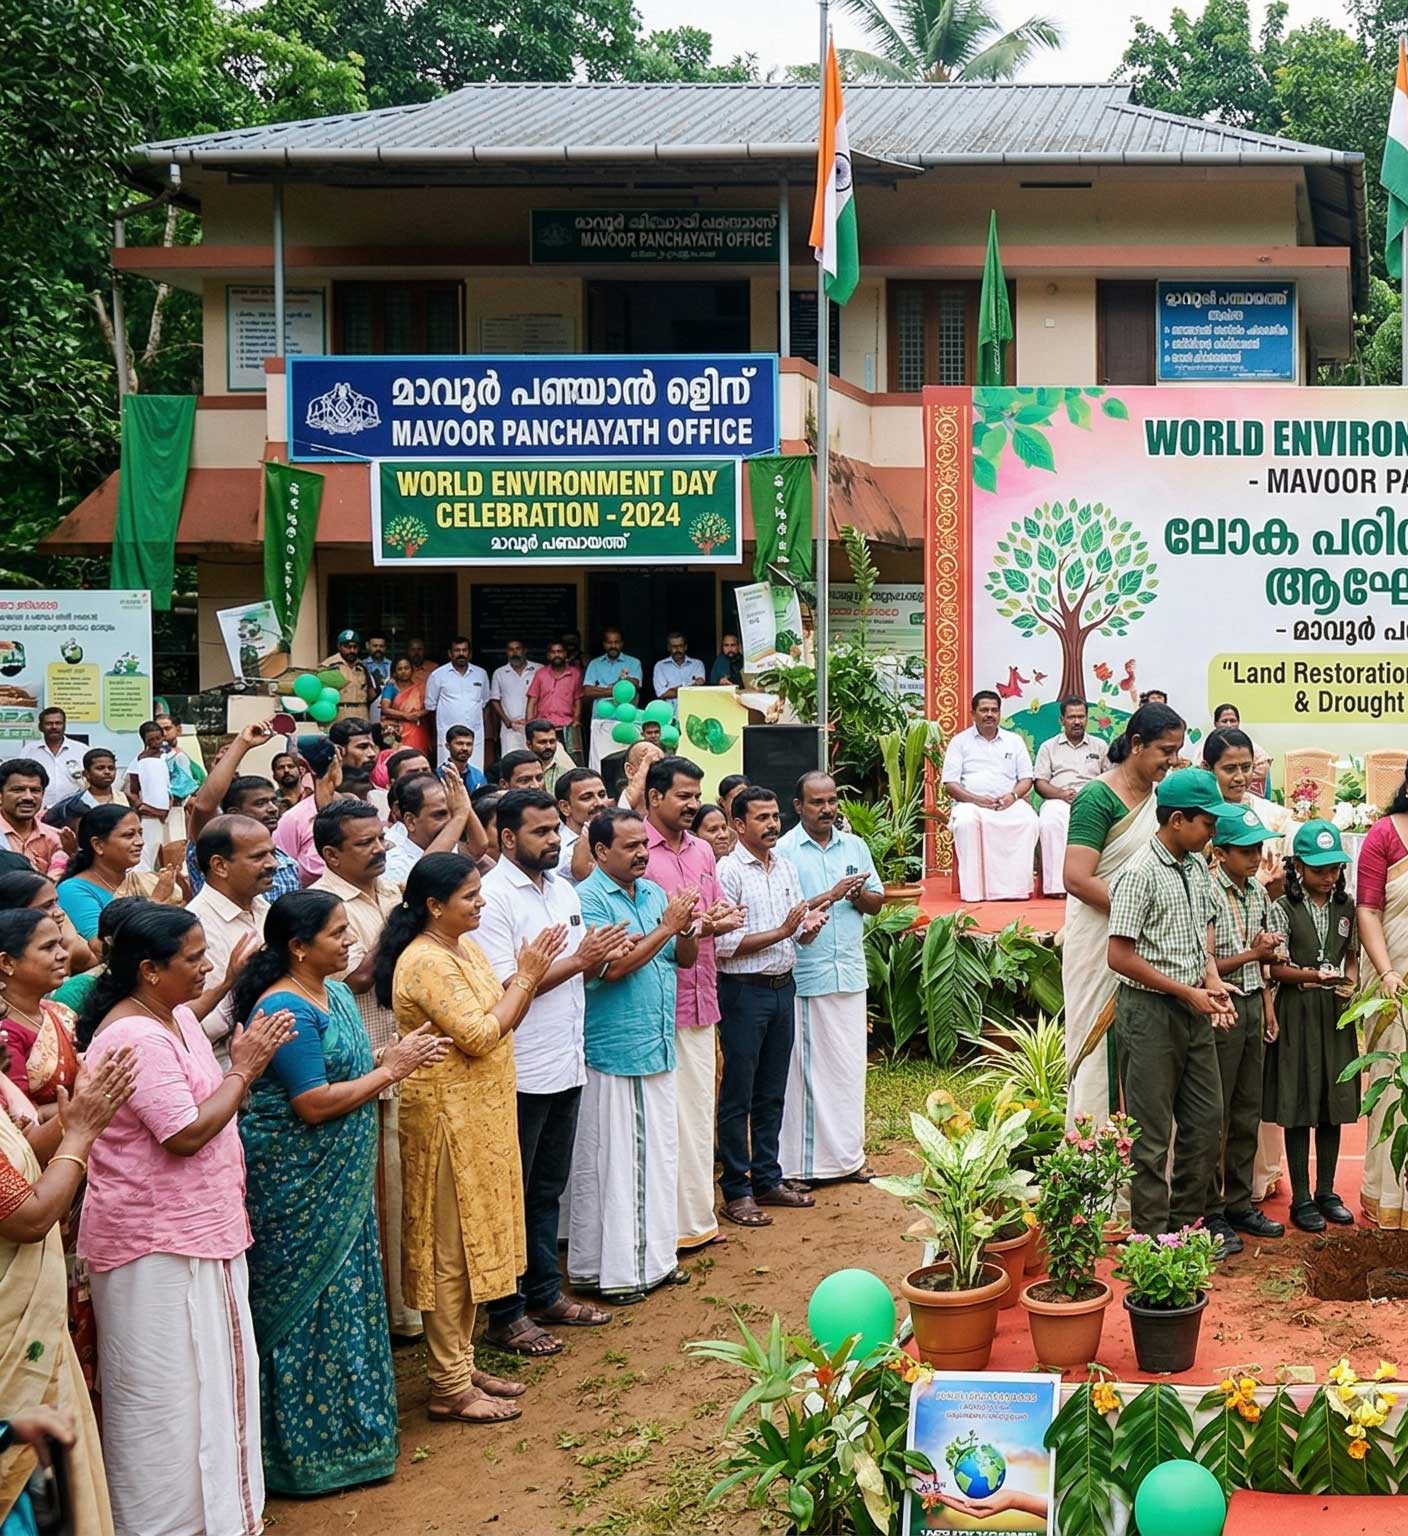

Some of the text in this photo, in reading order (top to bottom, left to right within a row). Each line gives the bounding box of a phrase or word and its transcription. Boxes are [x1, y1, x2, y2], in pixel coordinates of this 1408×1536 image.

[581, 232, 772, 247] MAVOOR PANCHAYATH OFFICE
[392, 370, 500, 414] മാവൂർ
[392, 418, 753, 446] MAVOOR PANCHAYATH OFFICE
[1145, 419, 1263, 457] WORLD
[396, 469, 718, 497] WORLD ENVIRONMENT DAY
[1267, 468, 1377, 495] MAVOOR
[436, 502, 599, 528] CELEBRATION
[491, 534, 539, 553] മാവൂർ
[1164, 517, 1299, 556] ലോക
[1293, 615, 1376, 646] മാവൂർ
[1294, 691, 1310, 713] &
[1318, 690, 1405, 718] Drought
